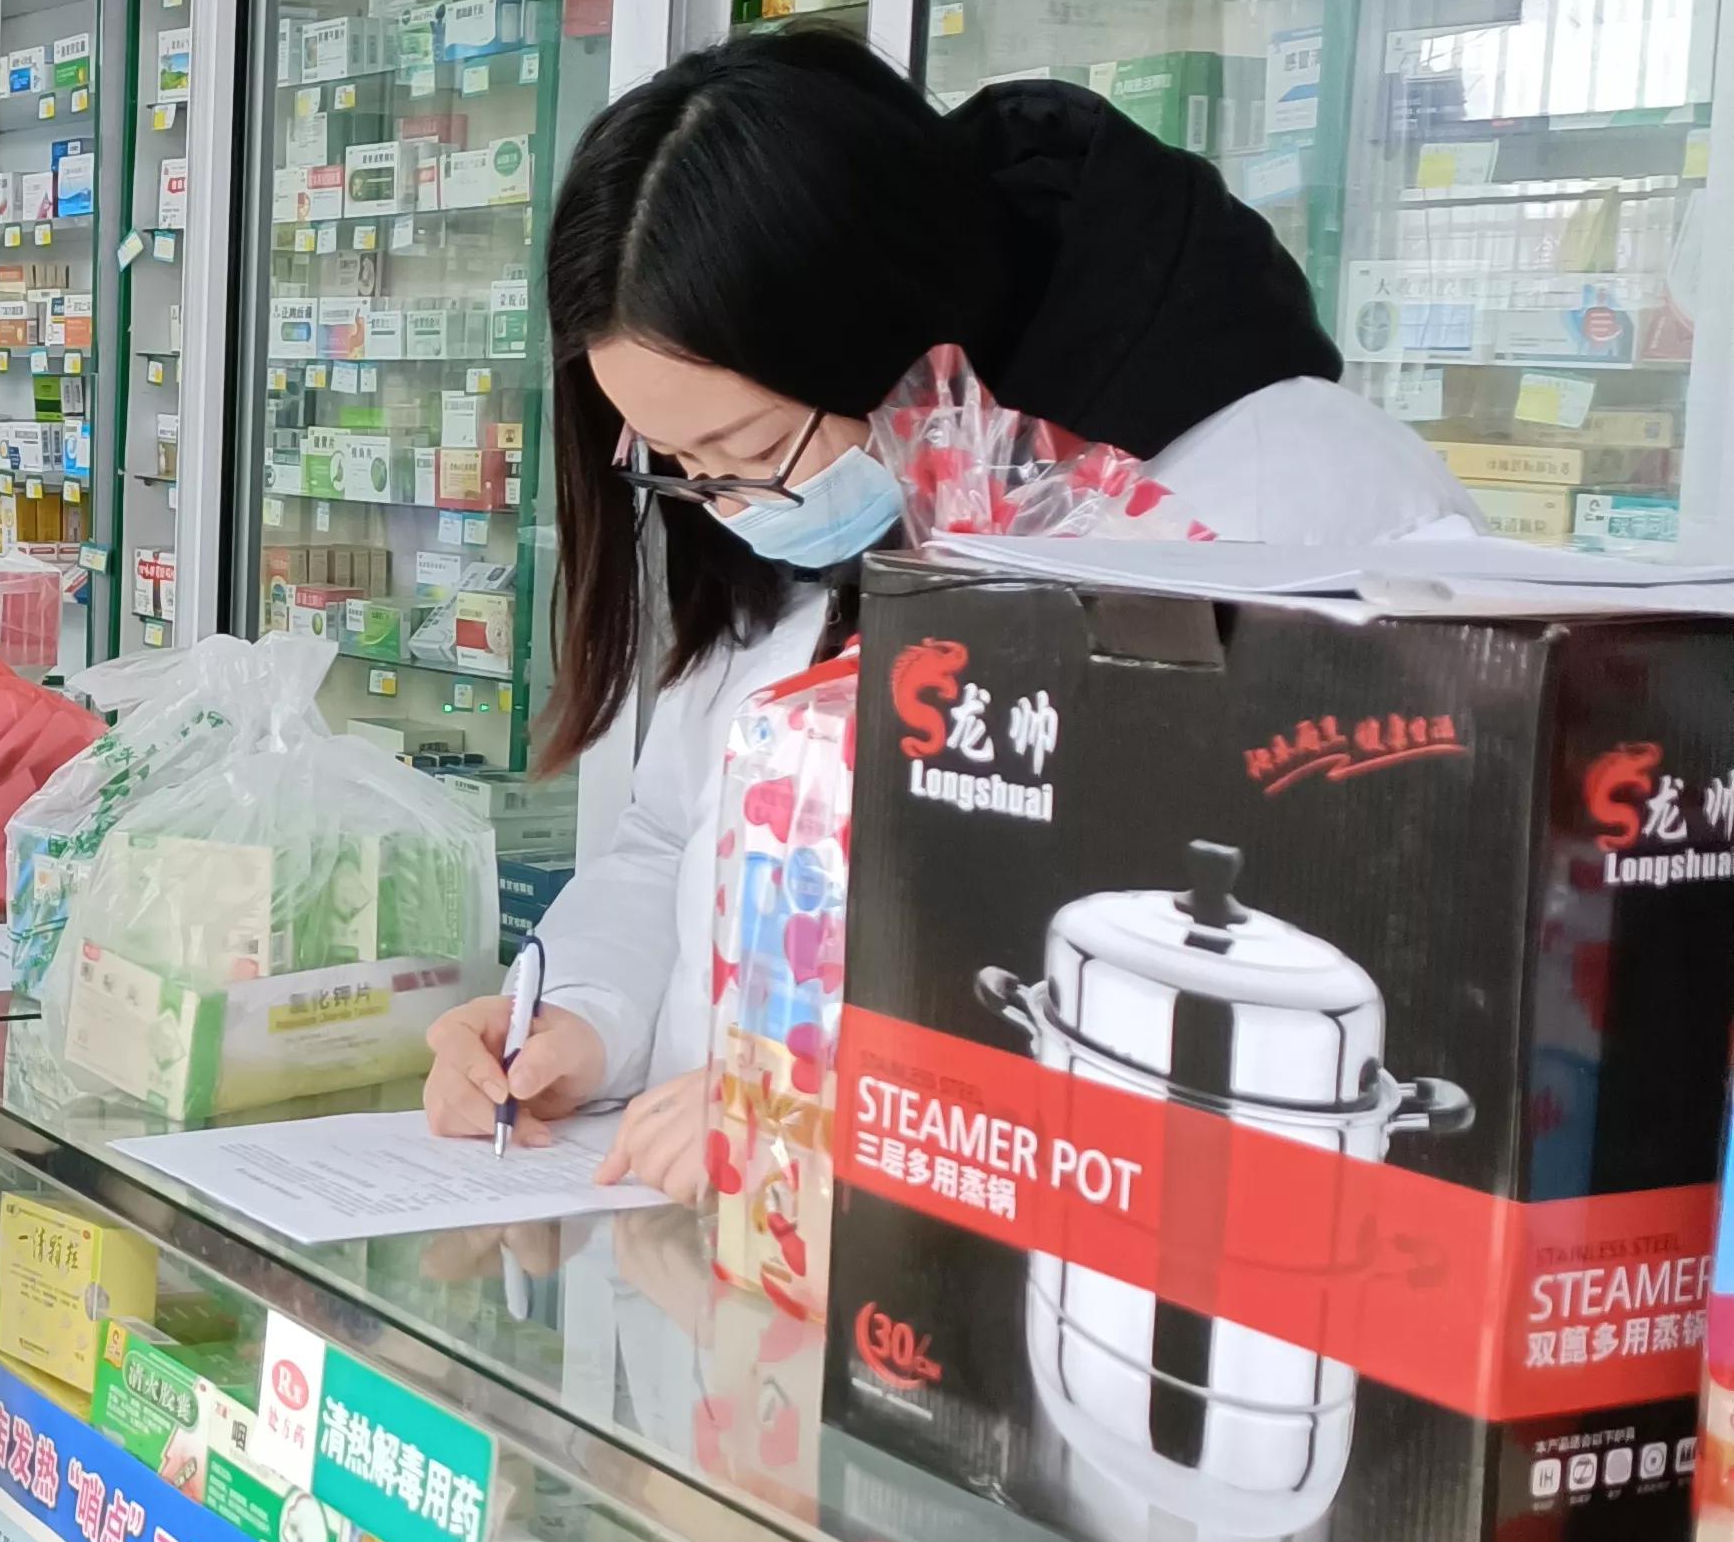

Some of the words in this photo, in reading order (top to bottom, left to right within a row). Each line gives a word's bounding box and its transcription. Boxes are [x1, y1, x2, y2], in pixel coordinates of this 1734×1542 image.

[950, 681, 1059, 778] 龙帅
[909, 759, 1055, 823] Longshuai
[855, 1133, 1019, 1222] 三层多用蒸锅
[857, 1073, 1040, 1180] STEAMER
[1051, 1138, 1143, 1213] POT
[16, 1228, 81, 1271] 一清颗粒
[268, 1405, 307, 1450] 处方药
